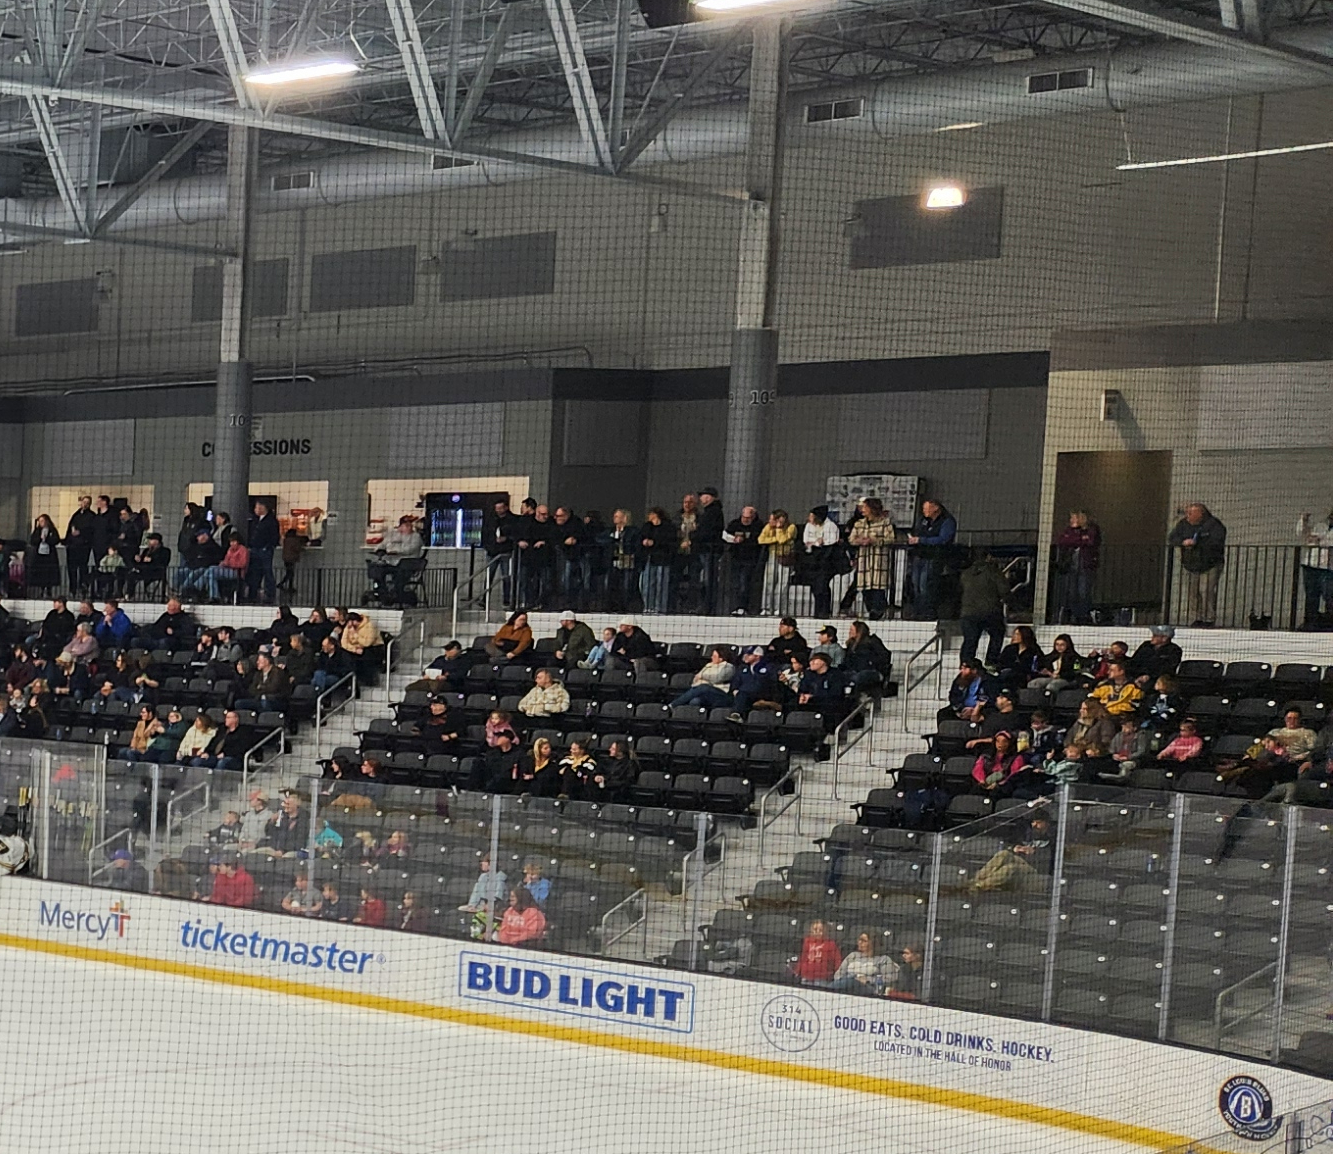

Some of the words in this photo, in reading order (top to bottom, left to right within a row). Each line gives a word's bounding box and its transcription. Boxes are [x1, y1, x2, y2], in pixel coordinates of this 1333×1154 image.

[201, 439, 312, 458] CSSIONS
[40, 900, 111, 940] Mercy
[466, 960, 552, 1000] BUD
[558, 974, 685, 1022] LIGHT
[781, 1004, 802, 1014] 314
[768, 1015, 814, 1034] SOCIAL
[834, 1015, 866, 1033] GOOD
[870, 1020, 905, 1039] EATS.
[909, 1026, 942, 1044] COLD
[946, 1031, 997, 1053] DRINKS.
[1001, 1040, 1054, 1063] HOCKEY.
[873, 1039, 912, 1056] LOCATED
[913, 1046, 923, 1058] IN
[925, 1048, 942, 1060] THE
[944, 1050, 966, 1064] HALL
[968, 1055, 979, 1067] OF
[982, 1058, 1012, 1072] HONOR
[1240, 1095, 1251, 1118] B
